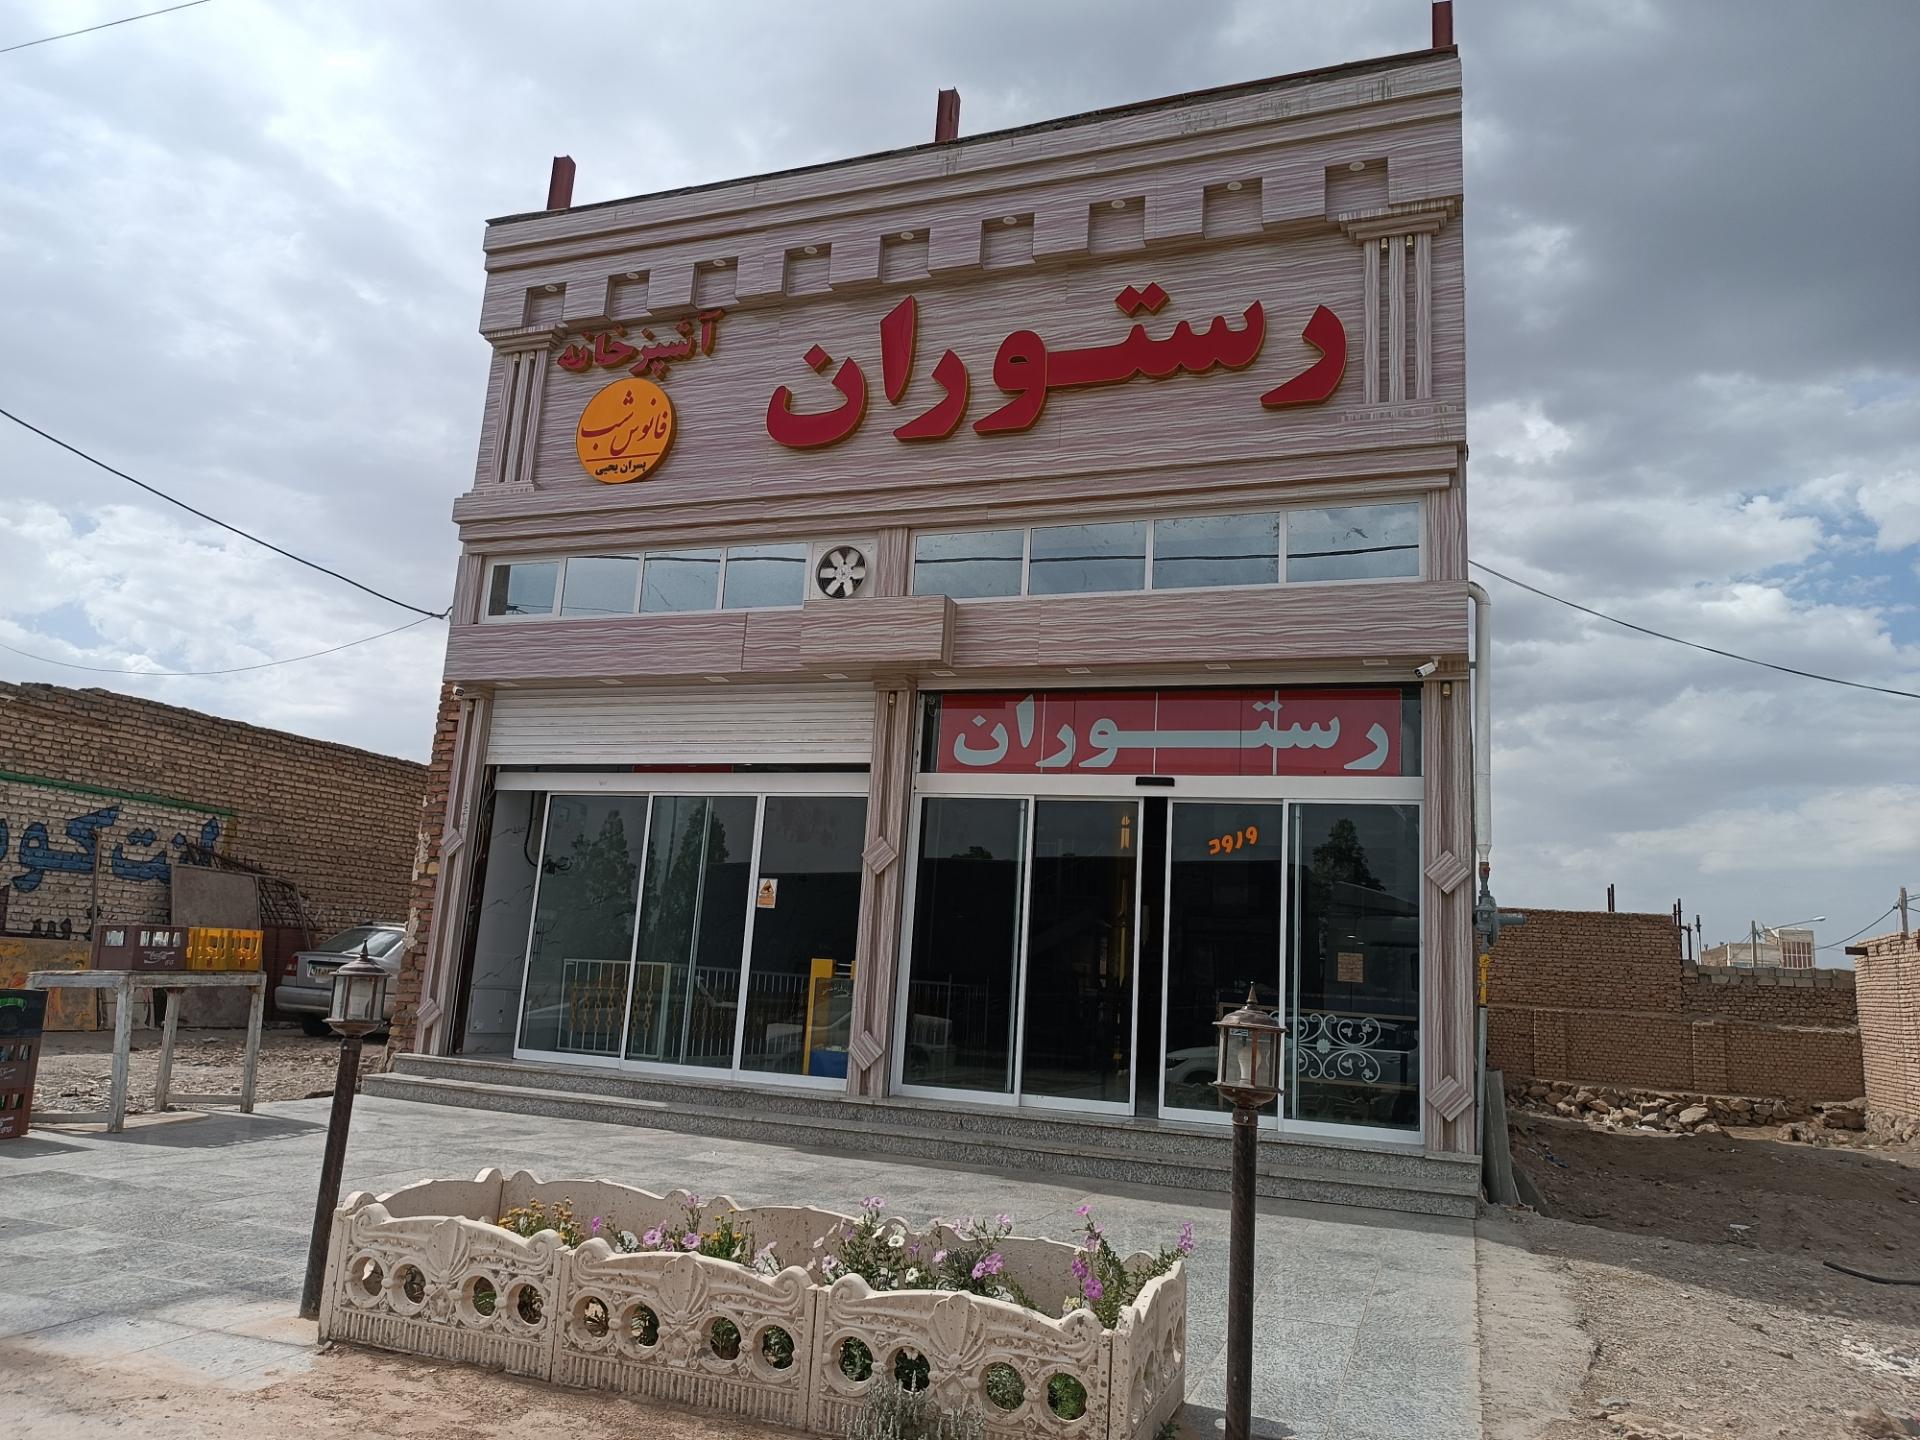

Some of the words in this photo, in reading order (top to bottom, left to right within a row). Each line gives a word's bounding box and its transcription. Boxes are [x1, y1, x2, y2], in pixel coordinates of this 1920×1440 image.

[557, 309, 725, 381] آشپزخانه
[766, 281, 1348, 450] رستوران
[581, 390, 634, 450] شب
[610, 398, 668, 456] فانوس
[953, 694, 1389, 769] رستوران
[1208, 826, 1258, 855] ورود
